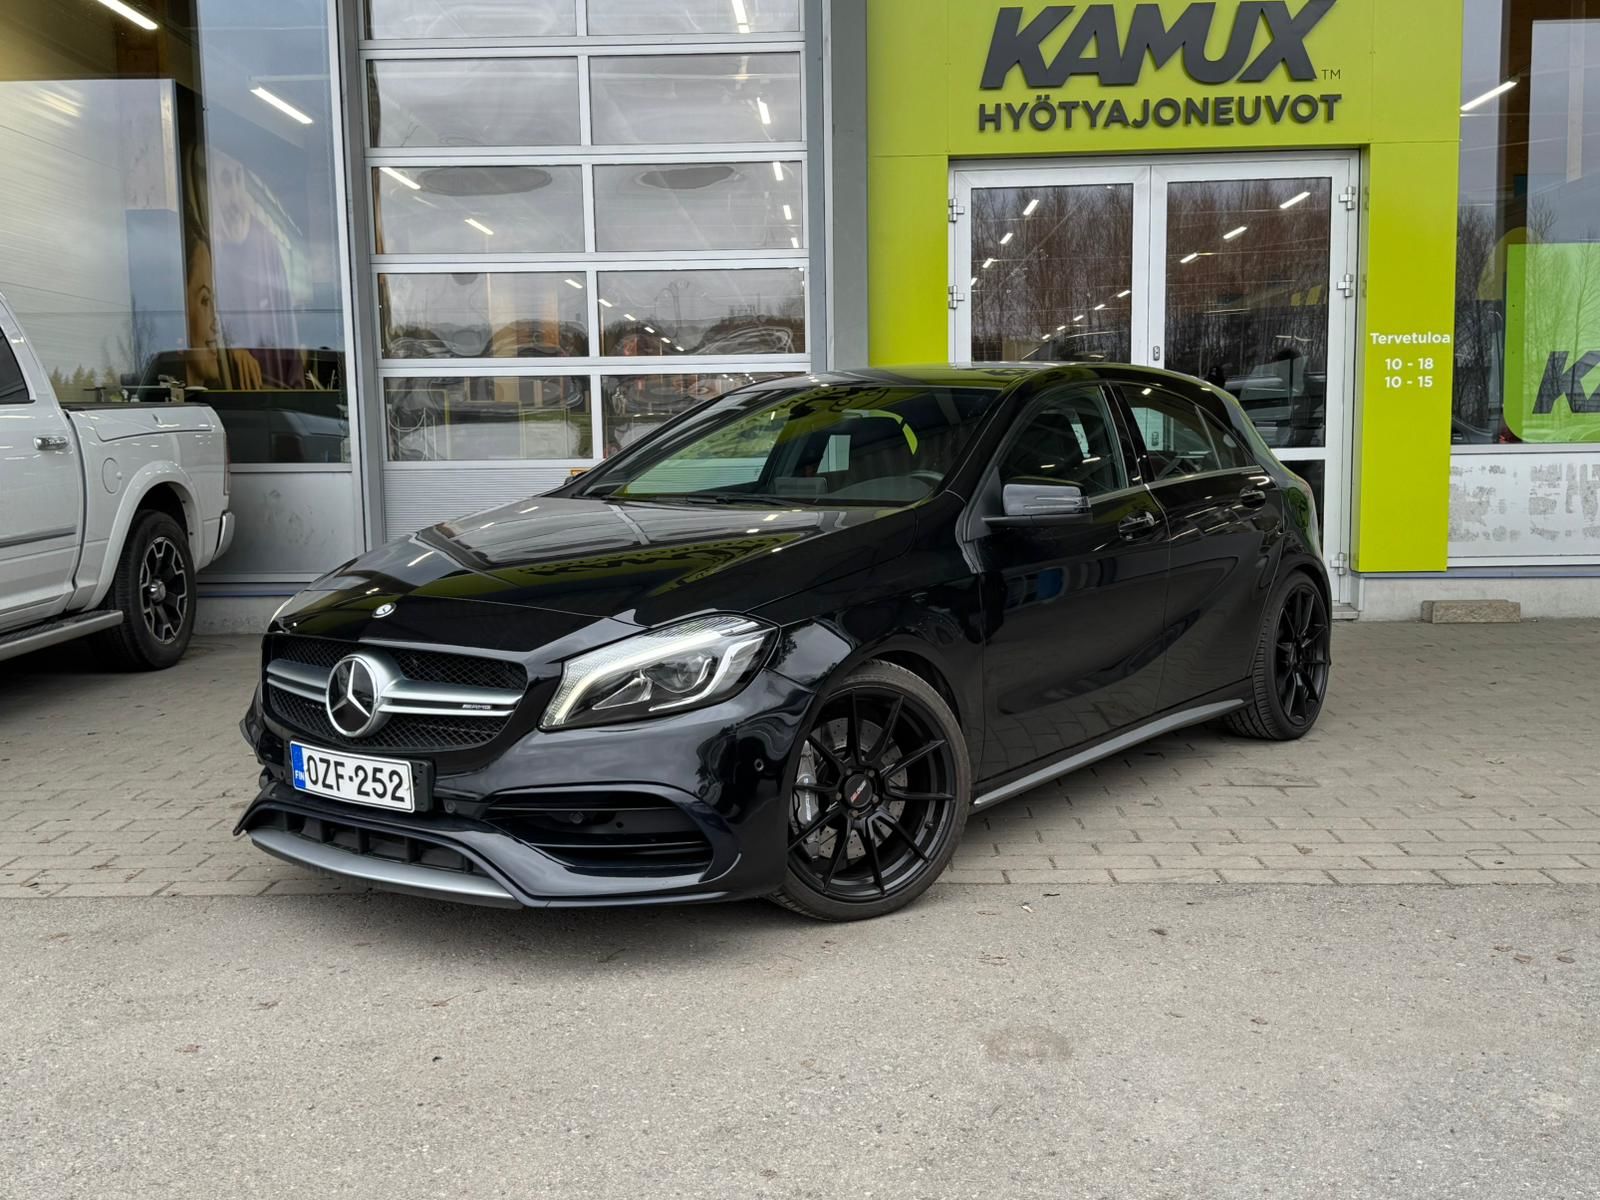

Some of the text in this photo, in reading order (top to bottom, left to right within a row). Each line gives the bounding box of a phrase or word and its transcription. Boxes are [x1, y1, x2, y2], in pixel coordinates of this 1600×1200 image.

[979, 0, 1337, 90] KAMUX
[979, 94, 1342, 131] HYÖTYAJONEUVOT
[1370, 332, 1451, 344] Tervetuloa
[1385, 358, 1402, 370] 10
[1418, 358, 1434, 370] 18
[1385, 376, 1402, 388] 10
[1418, 376, 1433, 388] 15
[306, 754, 406, 803] OZF-252
